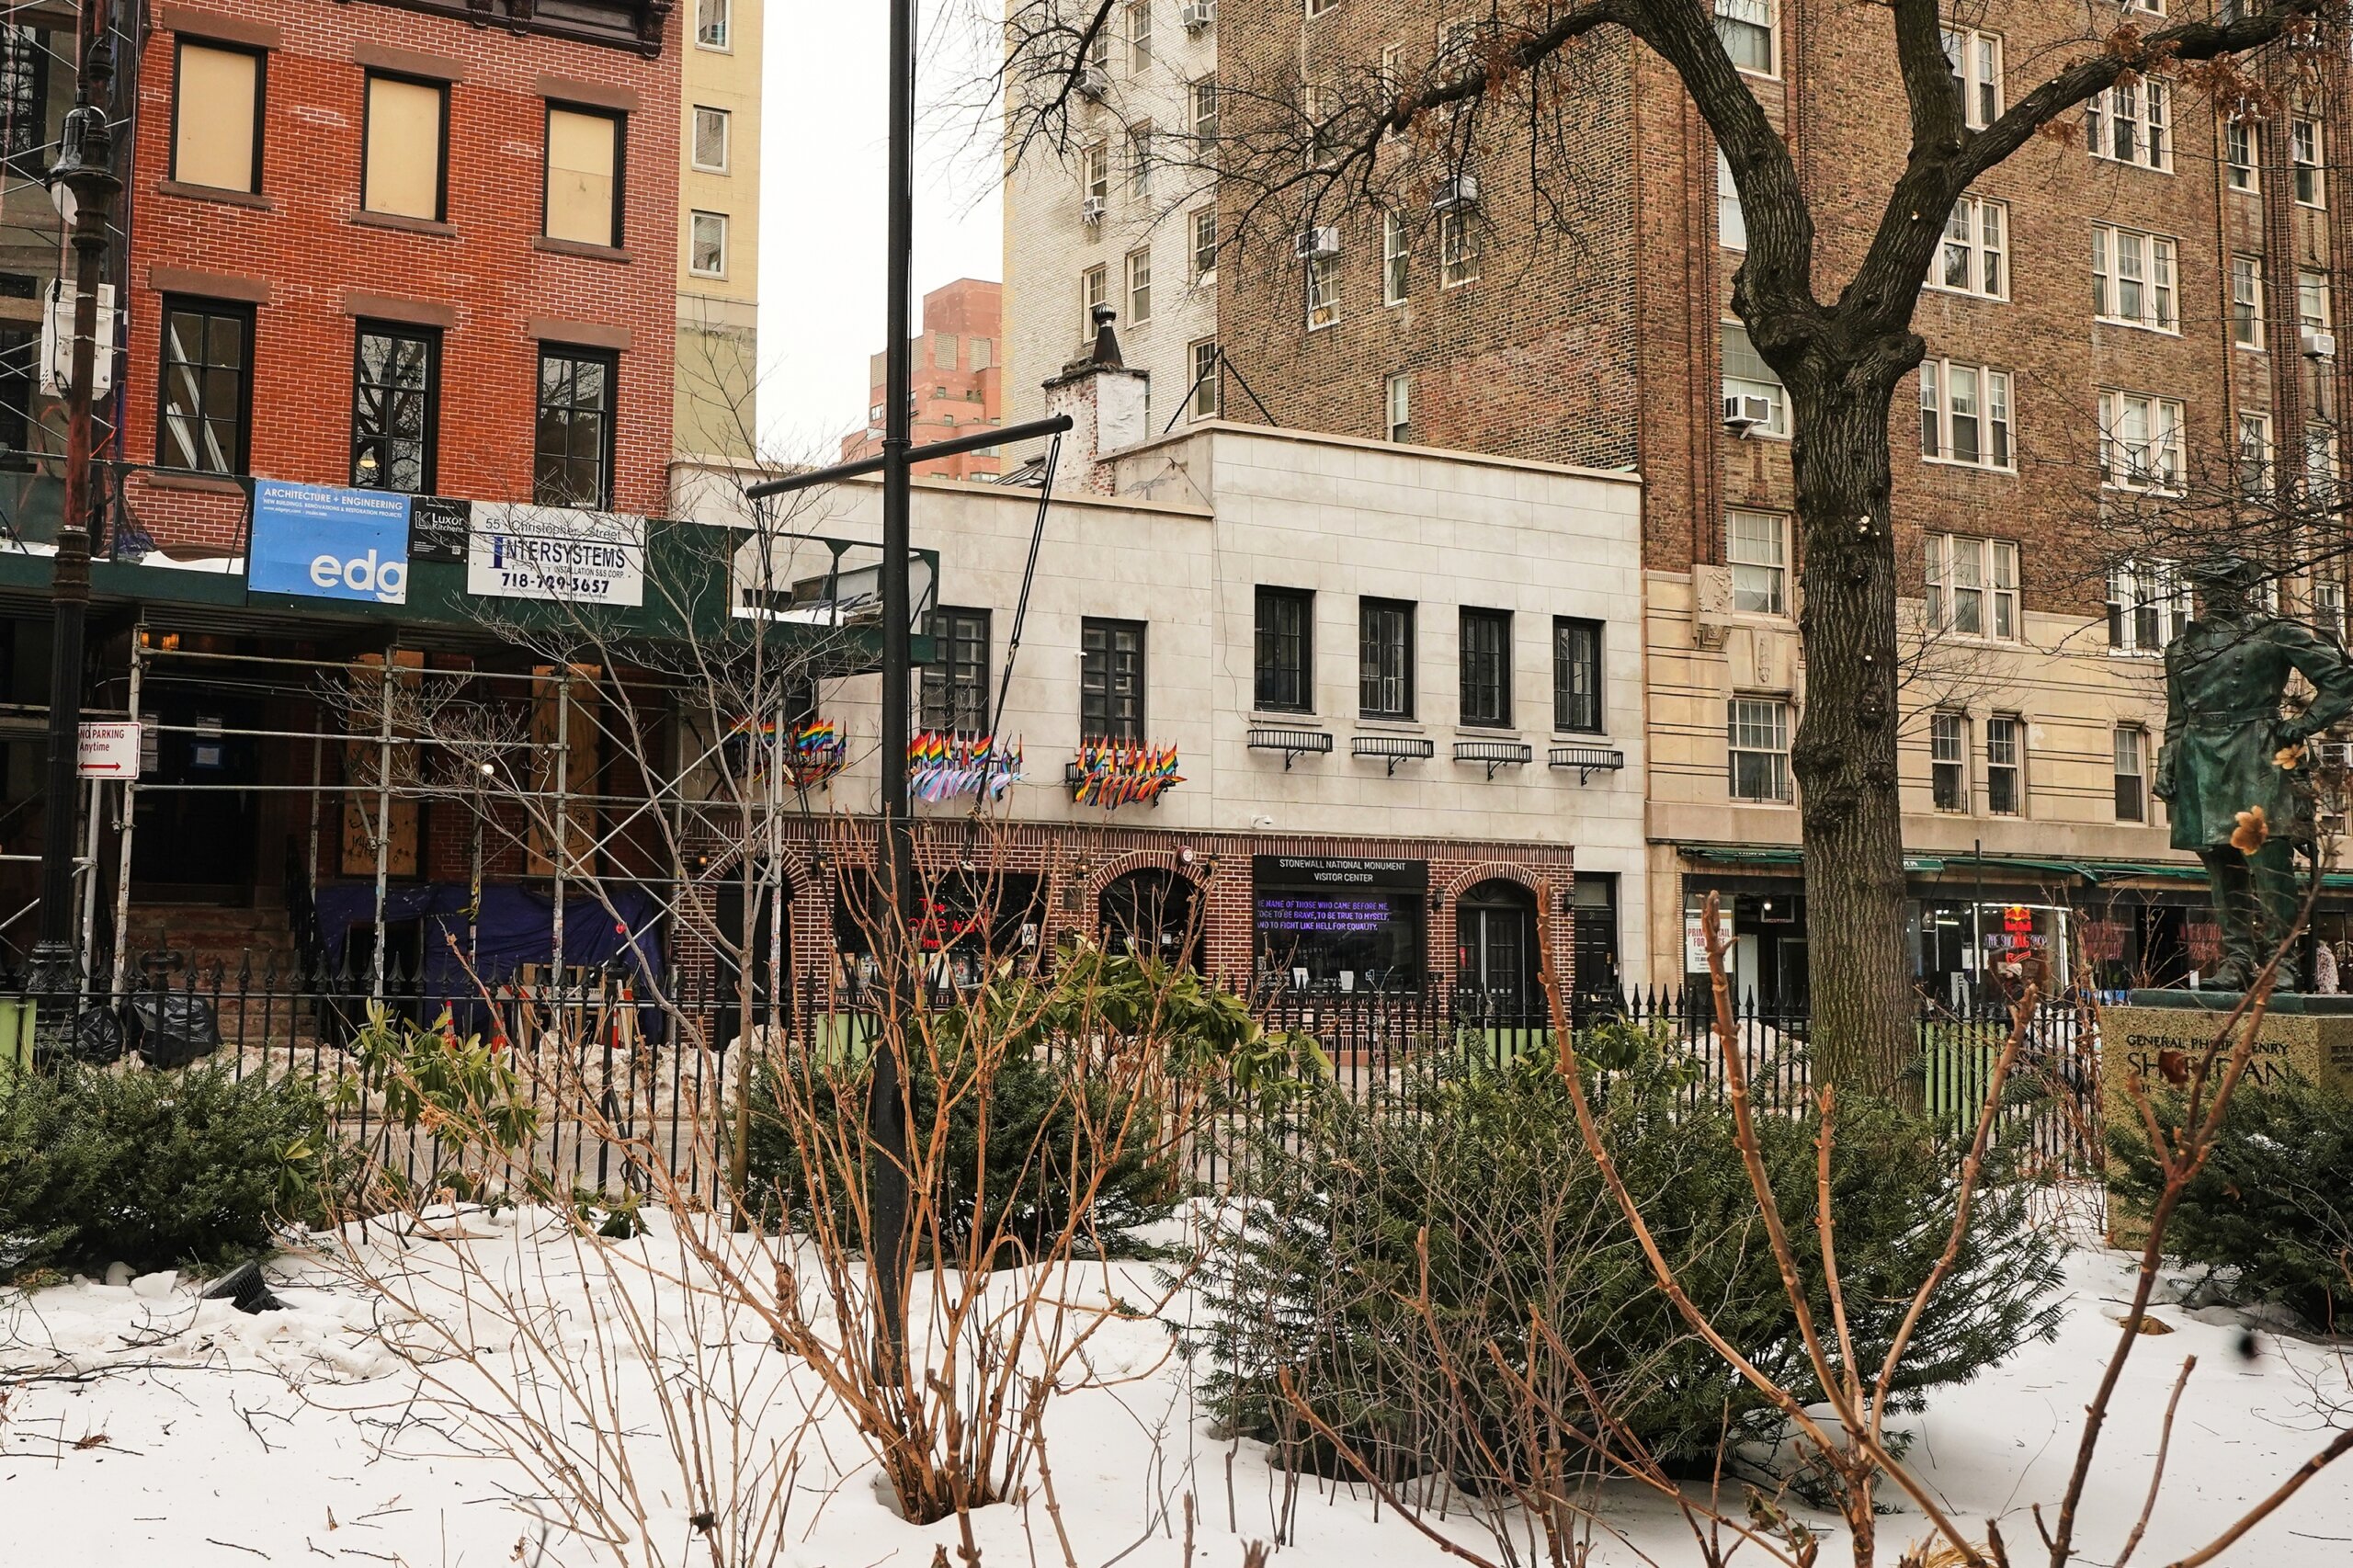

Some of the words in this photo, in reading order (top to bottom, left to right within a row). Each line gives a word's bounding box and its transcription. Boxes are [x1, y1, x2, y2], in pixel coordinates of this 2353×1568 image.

[263, 488, 331, 502] ARCHITECTURE
[341, 496, 404, 510] ENGINEERING
[305, 502, 340, 511] RENOVATIONS
[345, 507, 378, 516] RESTORATION
[378, 510, 403, 518] PROJECTS
[432, 512, 463, 525] Luxor
[432, 523, 464, 533] Kitchens
[485, 518, 501, 530] 55
[511, 520, 579, 536] Christopher
[590, 528, 621, 540] Street
[488, 535, 625, 569] INTERSYSTEMS
[310, 549, 407, 604] edg
[554, 565, 594, 576] INSTALLATION
[595, 568, 607, 577] S&S
[501, 572, 610, 593] 718-729-3657
[79, 729, 91, 739] NO
[92, 729, 125, 739] PARKING
[80, 741, 110, 753] Anytime
[1279, 859, 1324, 869] STONEWALL
[1326, 860, 1363, 869] NATIONAL
[1364, 862, 1406, 871] MONUMENT
[1314, 872, 1342, 881] VISITOR
[1344, 873, 1374, 882] CENTER
[919, 898, 946, 912] The
[1266, 900, 1284, 908] NAME
[1688, 928, 1703, 937] PRIM
[921, 935, 941, 949] Inn
[1694, 938, 1705, 947] FOR
[1984, 933, 1999, 948] THE
[2126, 1034, 2186, 1050] GENERAL
[2191, 1037, 2233, 1052] PHIP
[2251, 1041, 2289, 1056] ENRY
